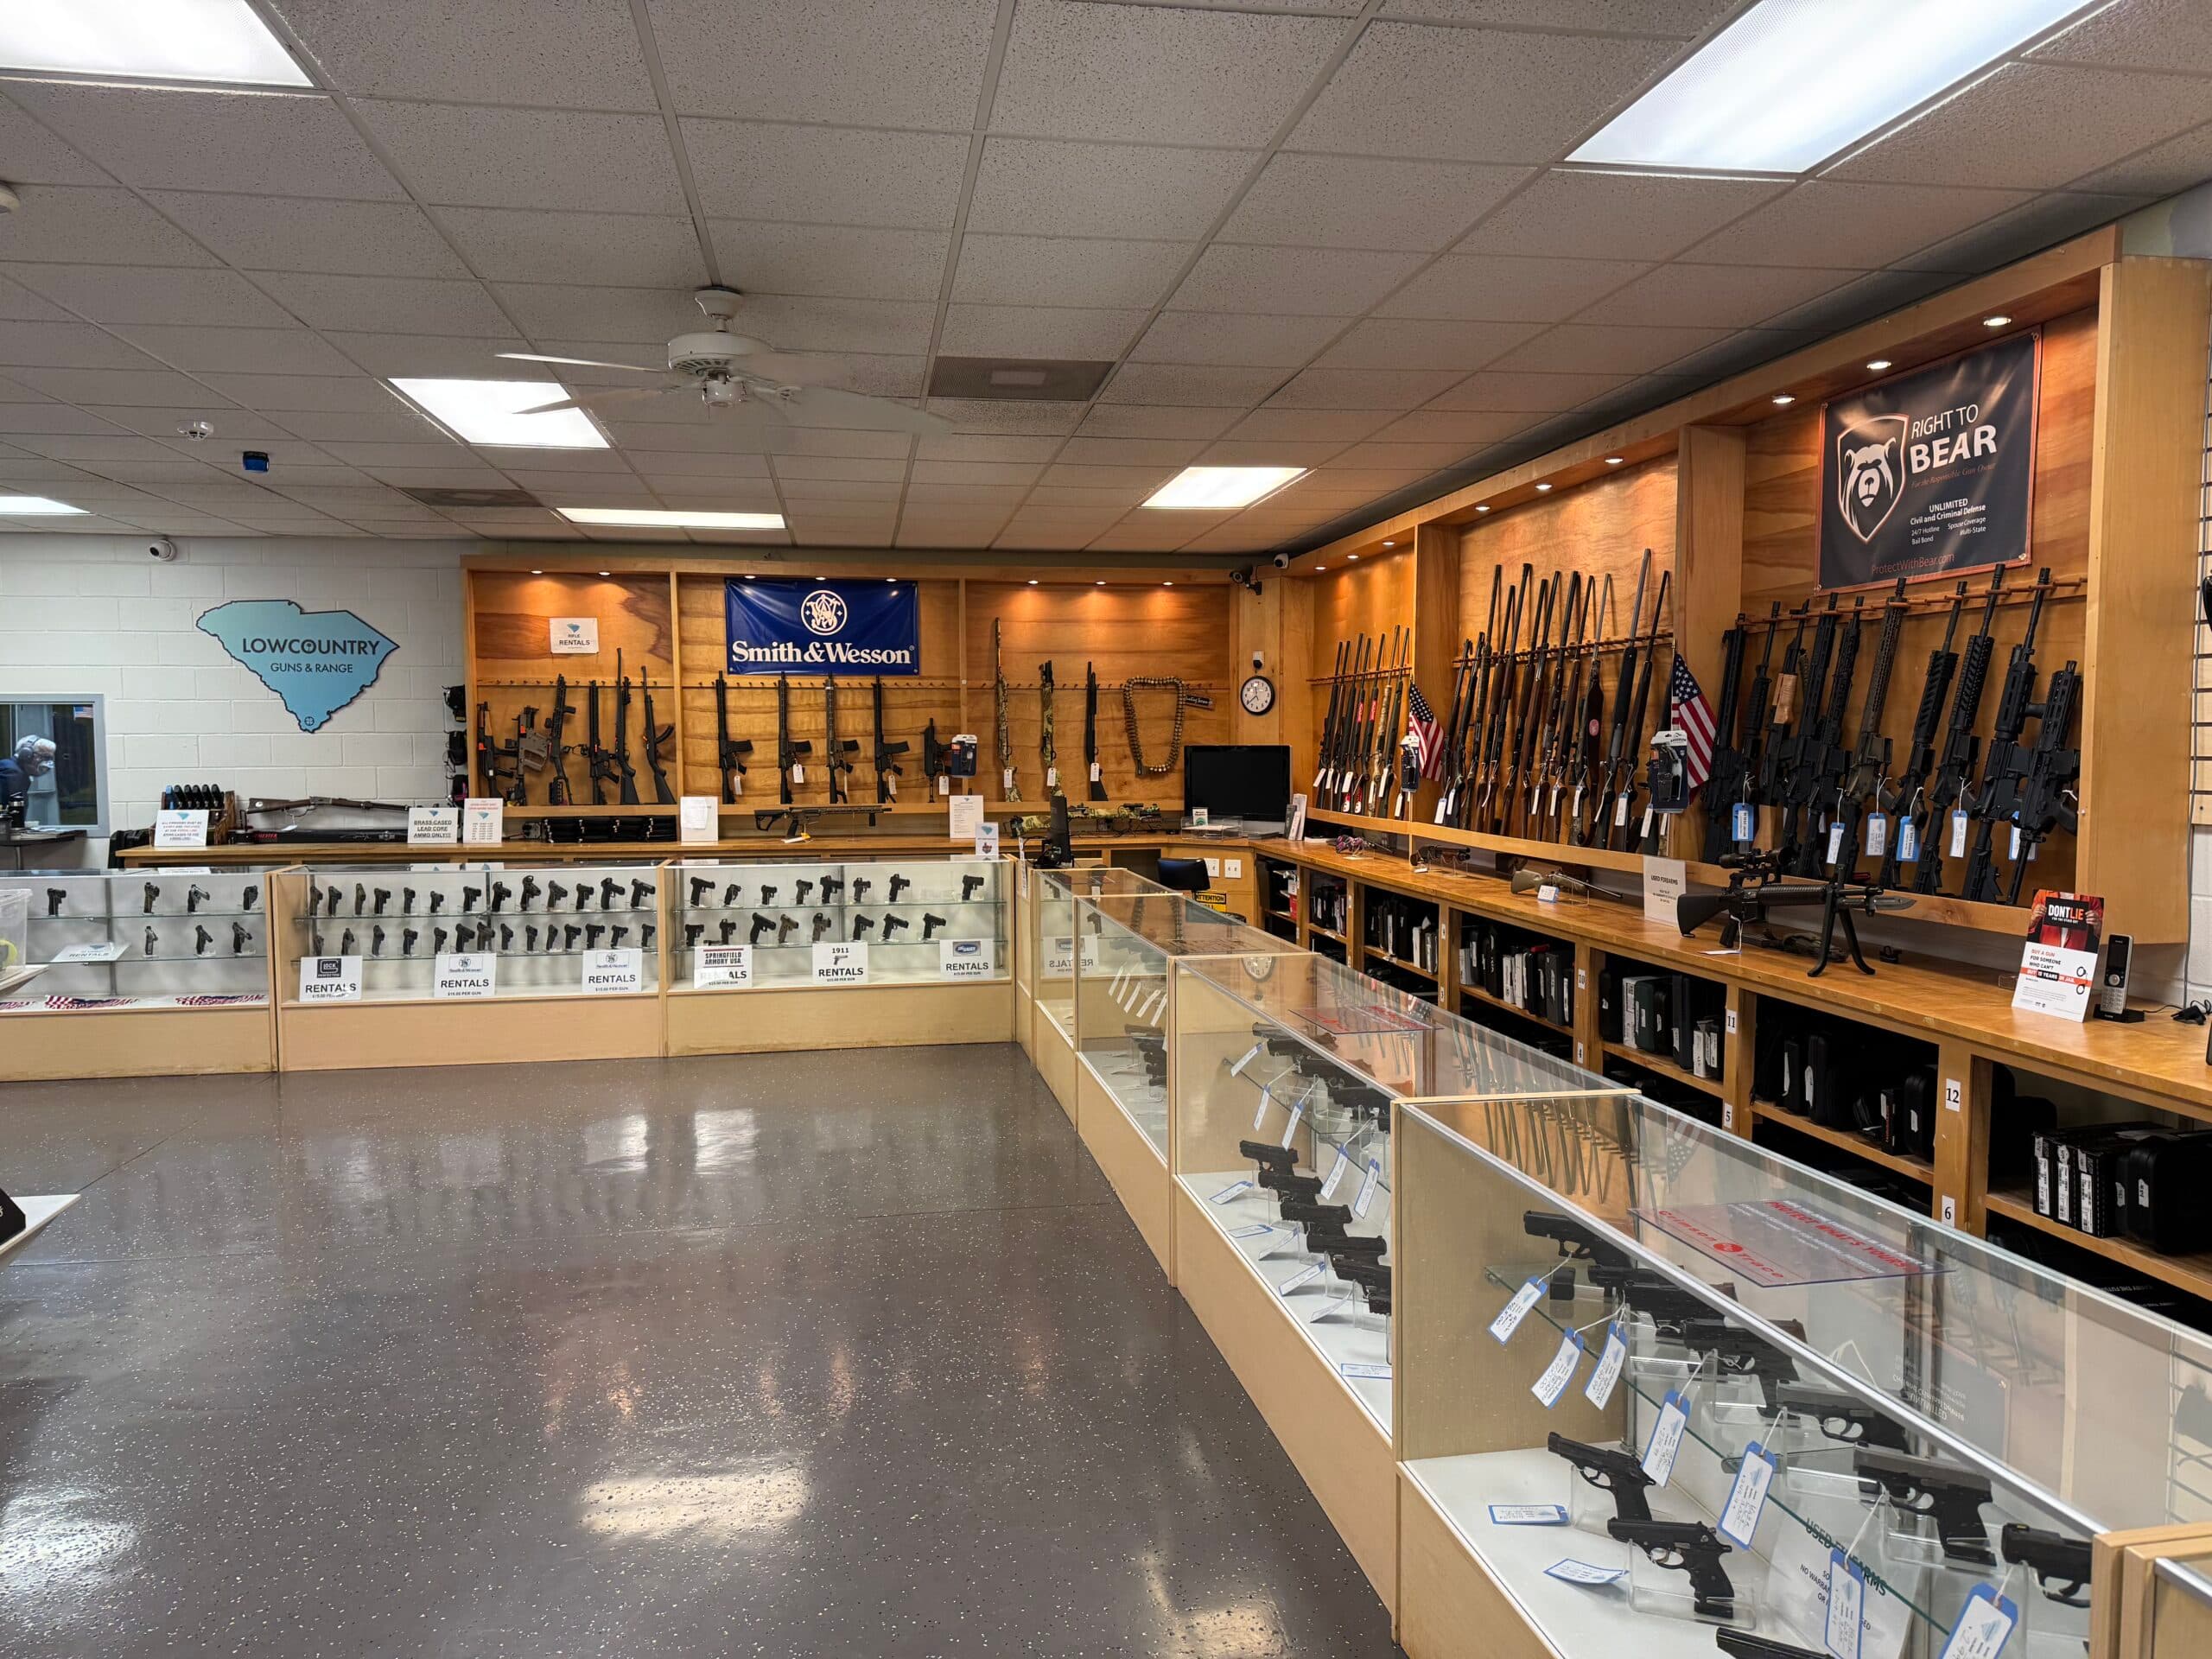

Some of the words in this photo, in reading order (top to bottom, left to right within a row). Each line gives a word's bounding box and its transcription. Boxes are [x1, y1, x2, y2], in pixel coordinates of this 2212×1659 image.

[1911, 410, 1954, 440] RIGHT
[1956, 404, 1979, 426] TO
[1910, 424, 1998, 474] BEAR
[1929, 498, 1968, 513] UNLIMITED
[1910, 516, 1923, 525] Civil
[1923, 513, 1936, 522] and
[1936, 508, 1963, 520] Criminal
[1963, 504, 1986, 515] Defense
[1948, 521, 1964, 530] Spouse
[1963, 517, 1986, 526] Coverage
[1959, 526, 1986, 536] Multi-State
[1921, 534, 1934, 543] Bond
[1872, 553, 1955, 575] ProtectWithBear.com
[242, 638, 380, 655] LOWCOUNTRY
[270, 663, 302, 673] GUNS
[304, 663, 314, 673] &
[315, 664, 353, 673] RANGE
[1660, 876, 1678, 885] FIREARMS
[2069, 906, 2084, 921] LIE
[945, 962, 989, 971] RENTALS
[2040, 957, 2061, 965] SOMEONE
[818, 967, 864, 977] RENTALS
[440, 978, 490, 988] RENTALS
[588, 974, 636, 984] RENTALS
[1727, 1014, 1736, 1028] 11
[1946, 1088, 1960, 1104] 12
[1725, 1110, 1731, 1122] 5
[1944, 1206, 1952, 1220] 6
[1658, 1211, 1717, 1242] Crimson
[1737, 1253, 1784, 1278] Trace
[1806, 1517, 1832, 1549] USED
[1800, 1564, 1808, 1575] NO
[1817, 1592, 1826, 1605] OR
